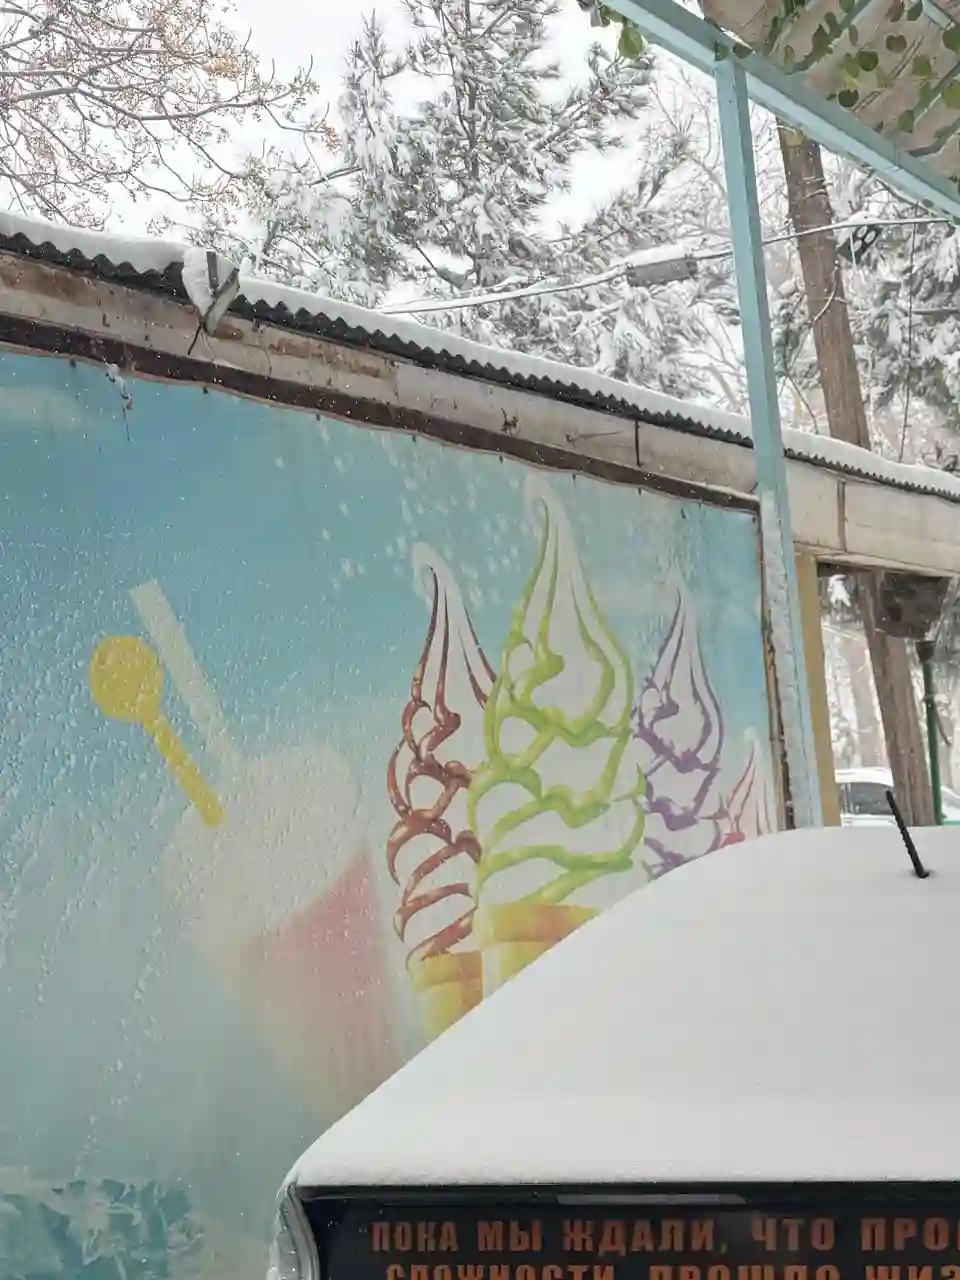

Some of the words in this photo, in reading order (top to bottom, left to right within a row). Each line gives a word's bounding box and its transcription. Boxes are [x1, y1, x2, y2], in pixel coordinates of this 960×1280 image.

[478, 1221, 543, 1252] МЫ
[564, 1220, 728, 1256] ЖДАЛИ,
[751, 1217, 837, 1251] ЧТО
